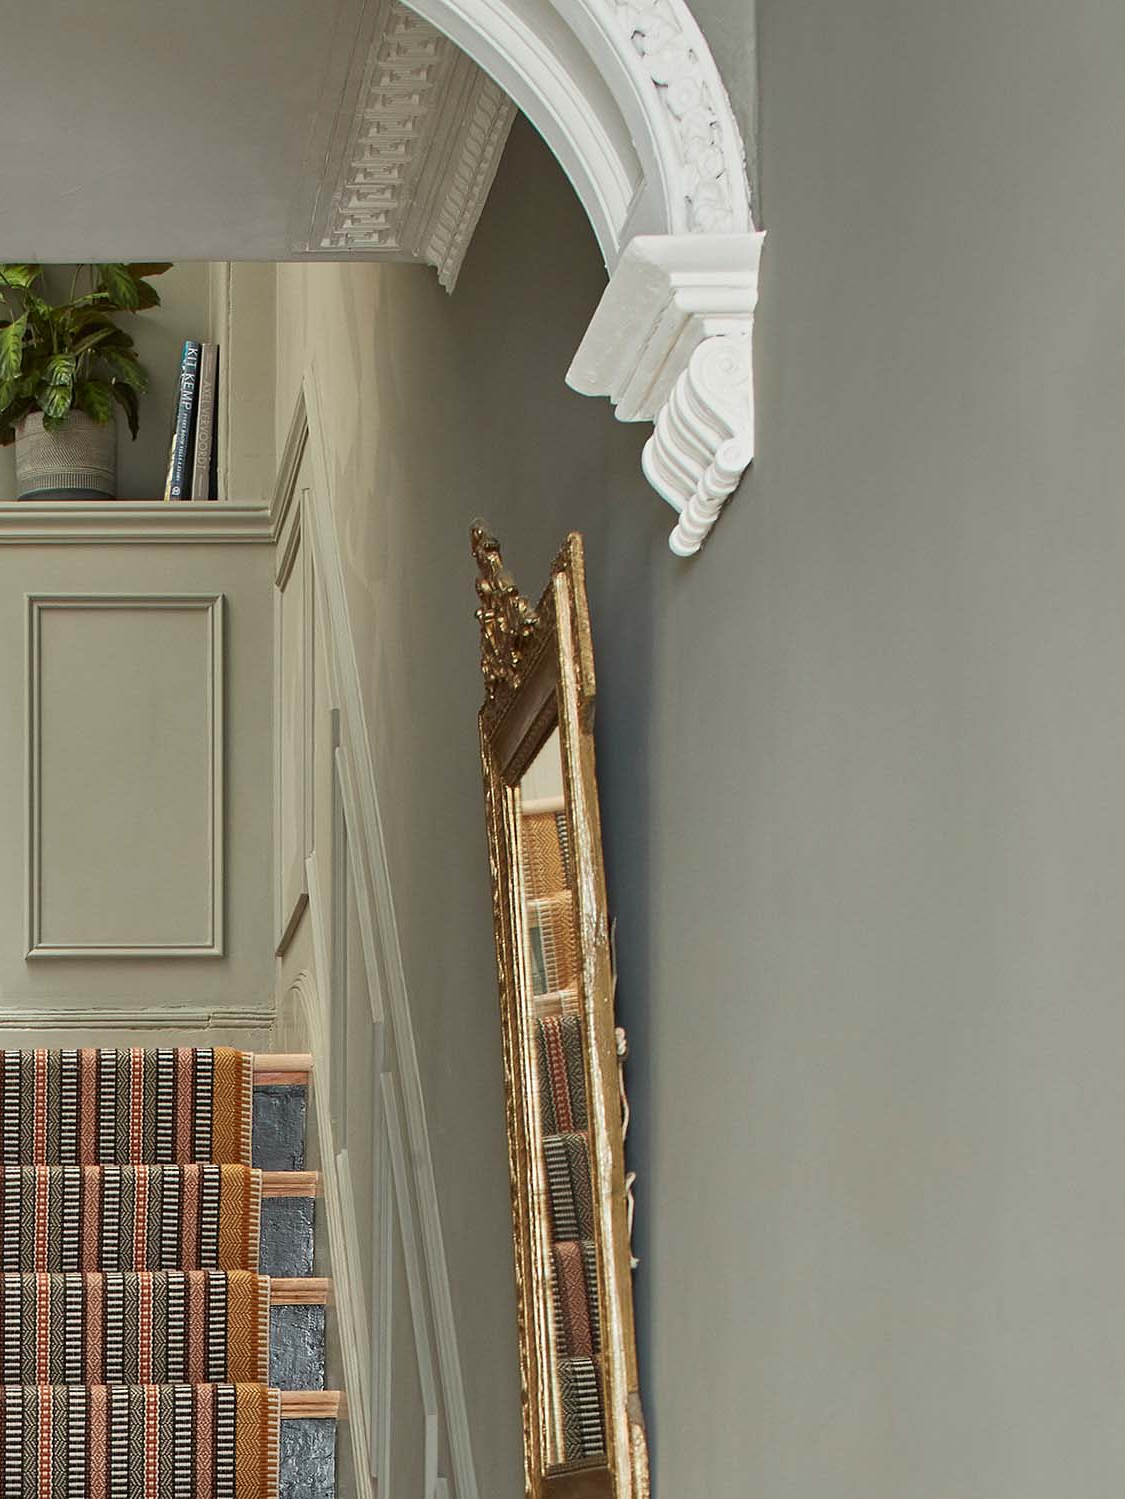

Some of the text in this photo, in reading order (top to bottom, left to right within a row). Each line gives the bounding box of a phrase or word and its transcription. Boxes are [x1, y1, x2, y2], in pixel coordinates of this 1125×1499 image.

[182, 348, 198, 410] KIT KEMP
[202, 380, 212, 404] AXEL
[197, 407, 210, 470] VERVOORDT
